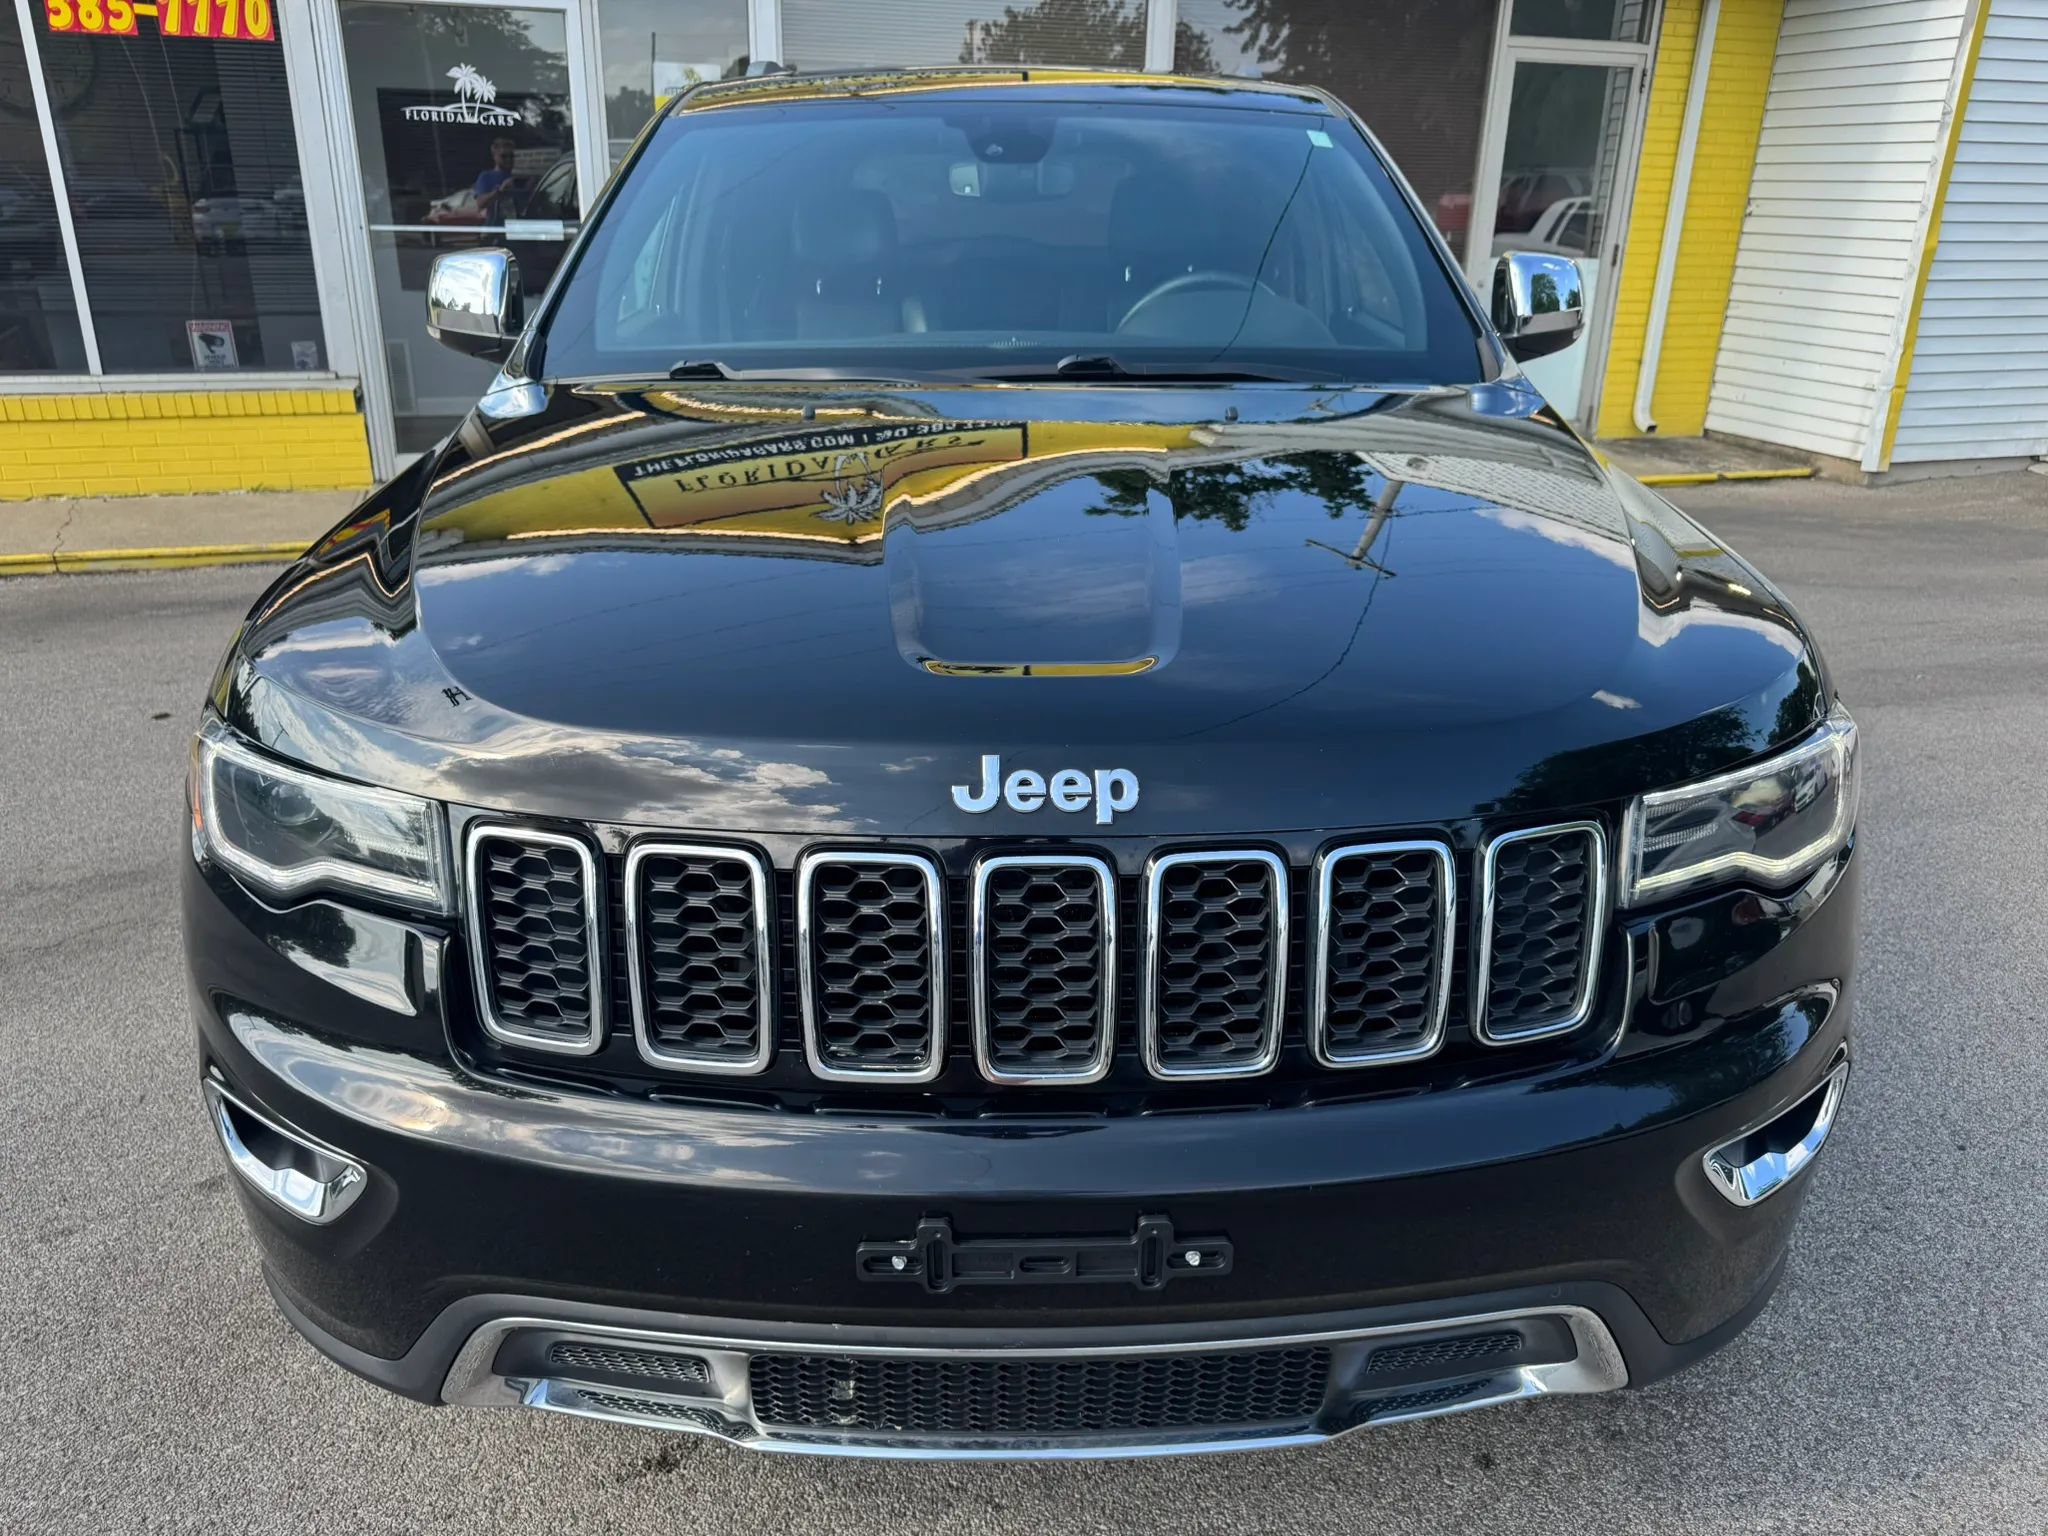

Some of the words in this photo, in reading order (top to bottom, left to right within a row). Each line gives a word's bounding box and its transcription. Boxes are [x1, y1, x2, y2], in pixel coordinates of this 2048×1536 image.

[405, 109, 464, 123] FLORIDA
[479, 112, 515, 127] CARS
[951, 754, 1140, 825] Jeep
